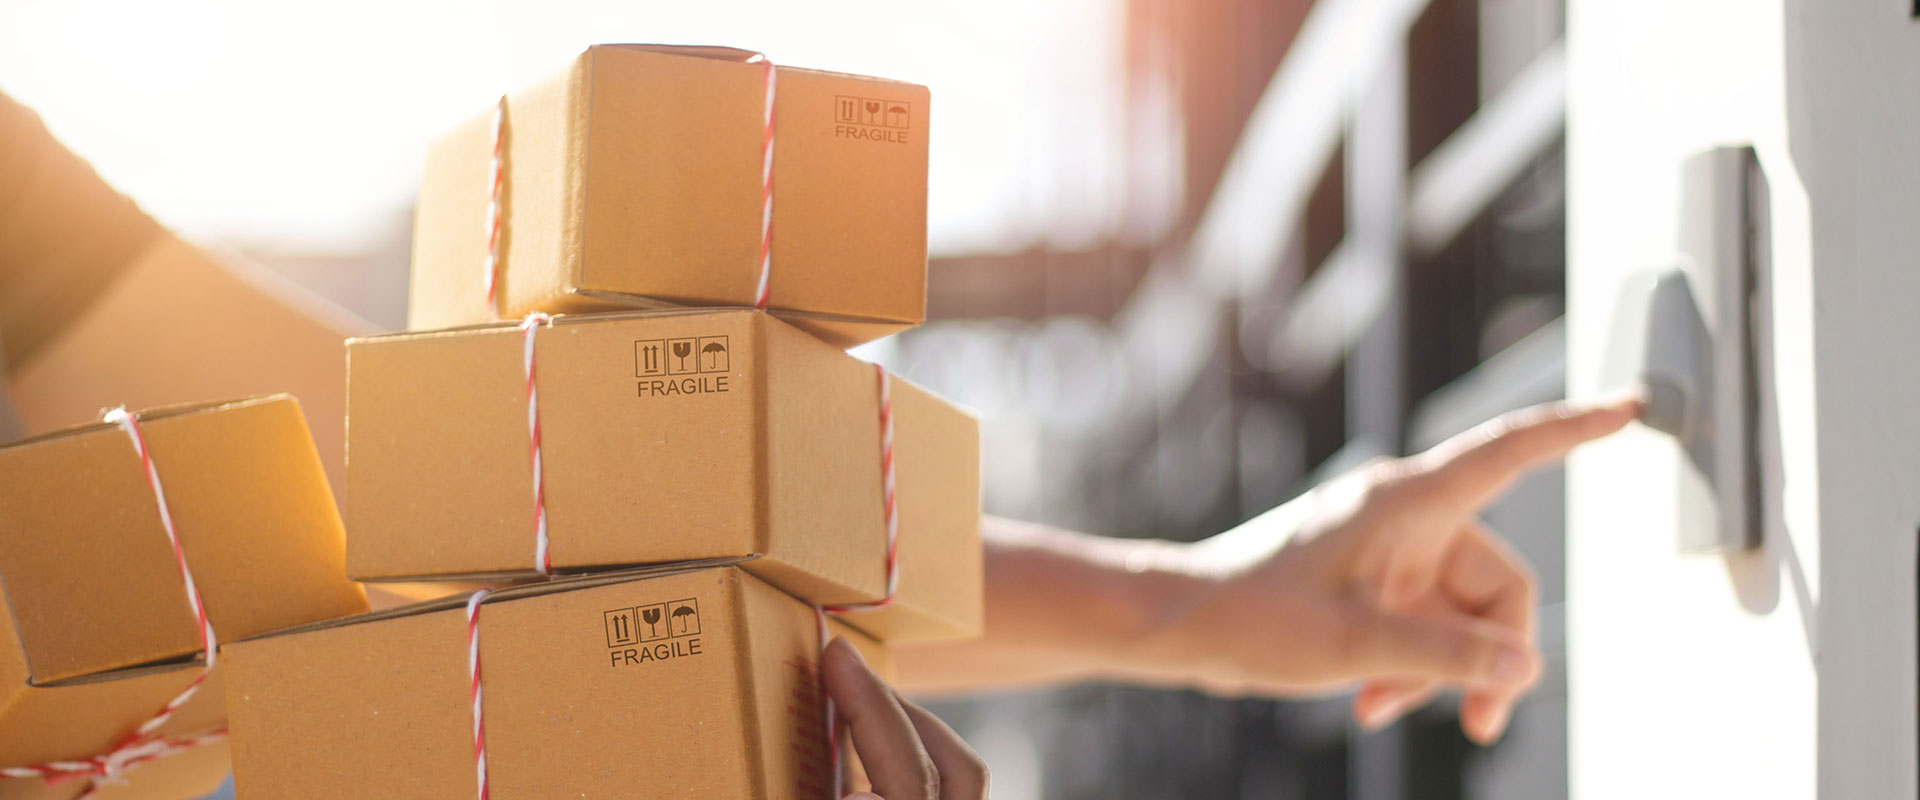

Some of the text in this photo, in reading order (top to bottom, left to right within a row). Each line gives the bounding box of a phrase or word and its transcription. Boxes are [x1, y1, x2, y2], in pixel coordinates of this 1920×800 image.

[835, 125, 908, 144] FRAGILE
[638, 376, 729, 397] FRAGILE
[611, 638, 702, 667] FRAGILE
